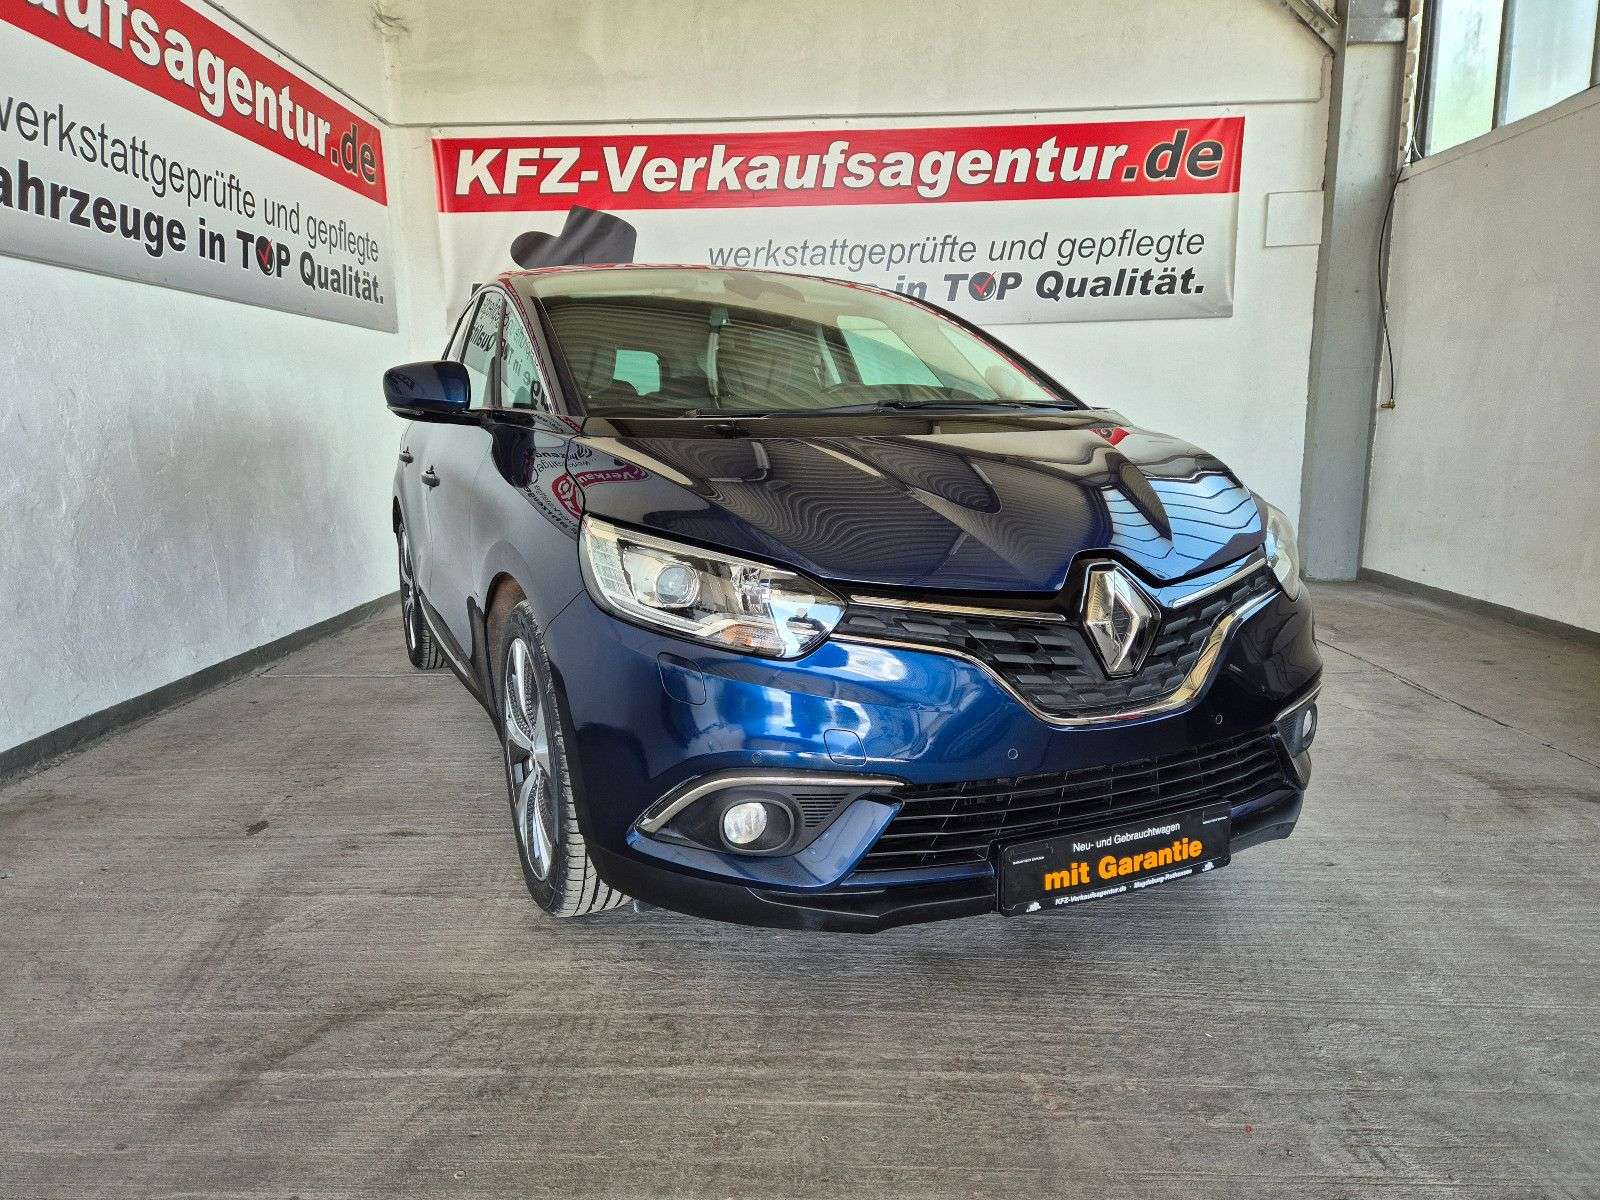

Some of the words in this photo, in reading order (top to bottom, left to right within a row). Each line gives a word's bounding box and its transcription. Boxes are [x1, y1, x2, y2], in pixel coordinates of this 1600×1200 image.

[27, 0, 376, 184] ufsagentur.de
[455, 128, 1224, 199] KFZ-Verkaufsagentur.de
[199, 217, 226, 263] in
[236, 229, 291, 278] TOP
[299, 252, 384, 304] Qualität.
[264, 197, 300, 235] und
[306, 213, 379, 266] gepflegte
[708, 236, 977, 272] werkstattgeprüfte
[988, 231, 1049, 262] und
[1057, 228, 1205, 266] gepflegte
[895, 275, 928, 301] in
[943, 271, 1023, 302] TOP
[1035, 267, 1205, 301] Qualität.
[1043, 860, 1090, 891] mit
[1098, 837, 1203, 880] Garantie
[1072, 841, 1094, 853] Neu-
[1096, 835, 1112, 848] und
[1113, 822, 1181, 846] Gebrauchtwagen
